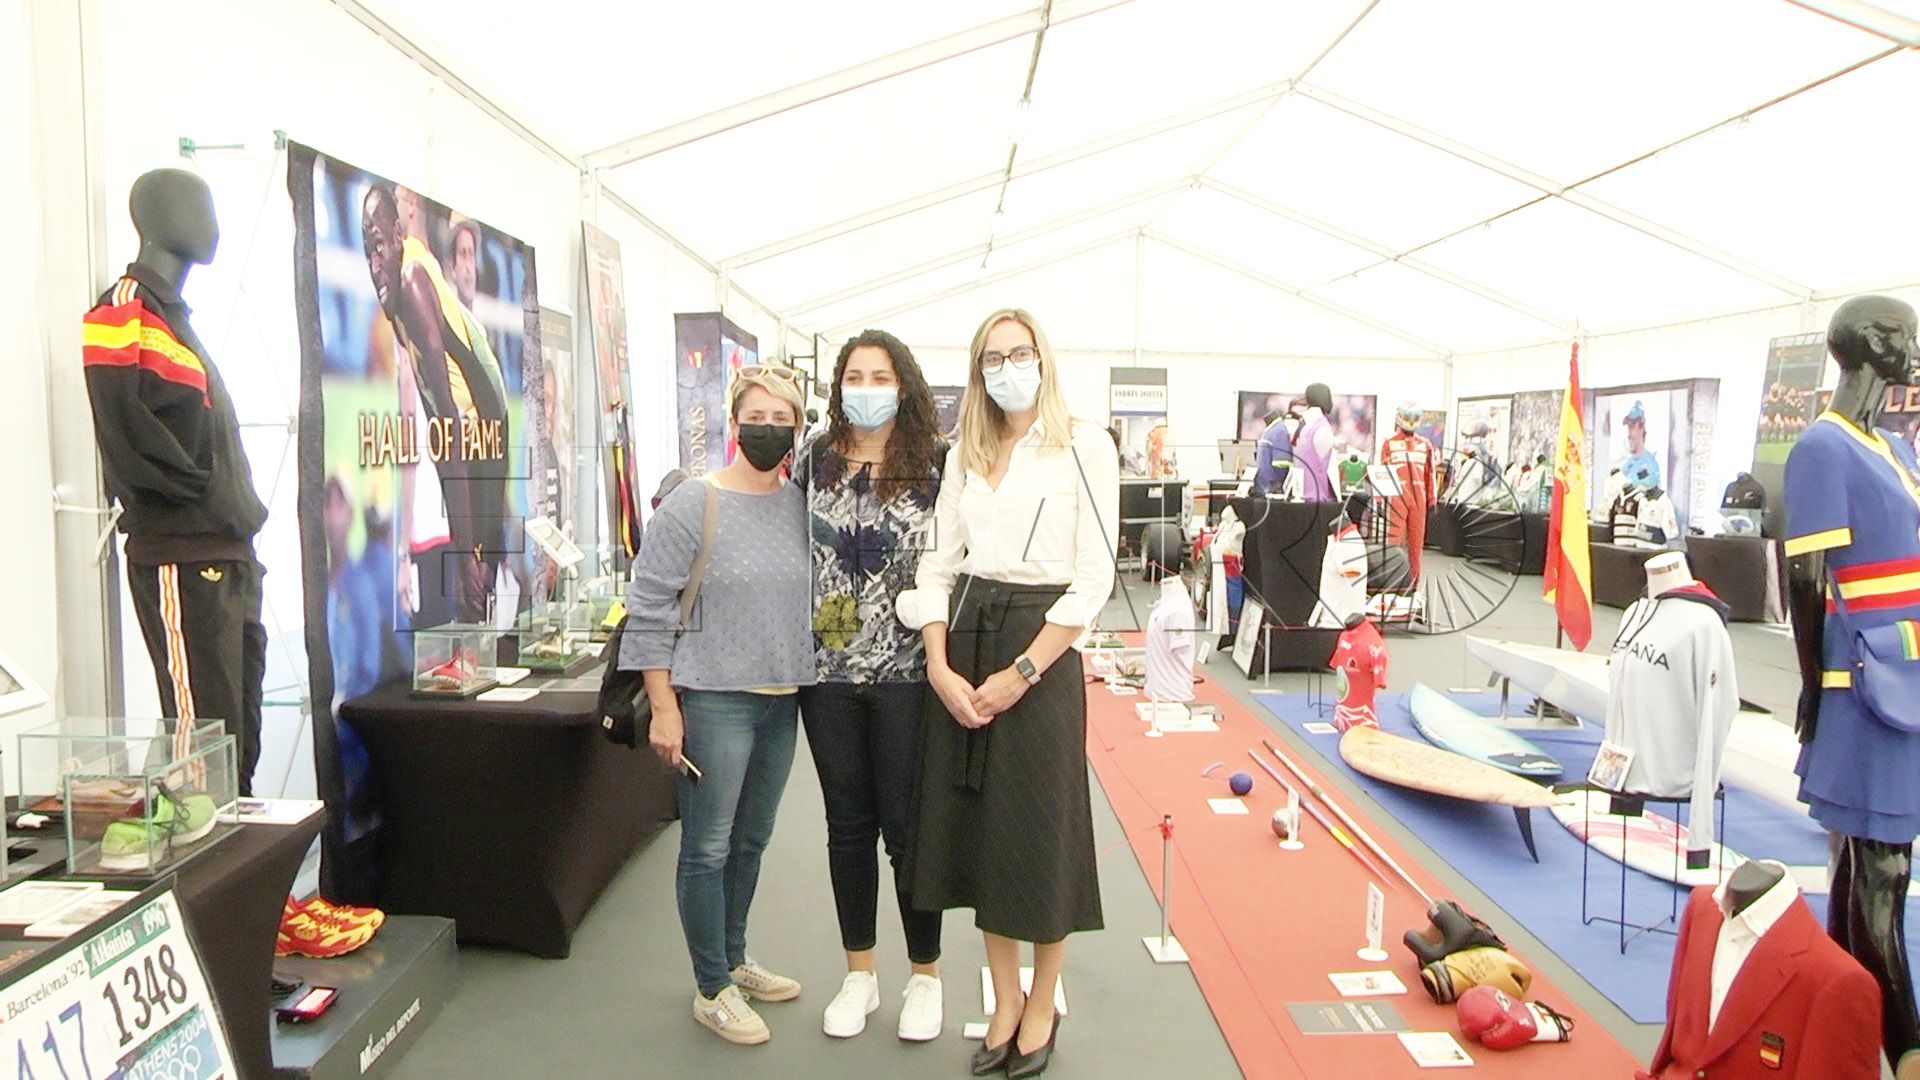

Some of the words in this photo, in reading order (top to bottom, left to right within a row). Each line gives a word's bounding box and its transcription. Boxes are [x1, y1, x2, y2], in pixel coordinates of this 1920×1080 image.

[359, 414, 420, 466] HALL
[427, 416, 453, 462] OF
[460, 416, 503, 461] FAME
[88, 927, 136, 971] Atlanta
[102, 943, 187, 1047] 1348
